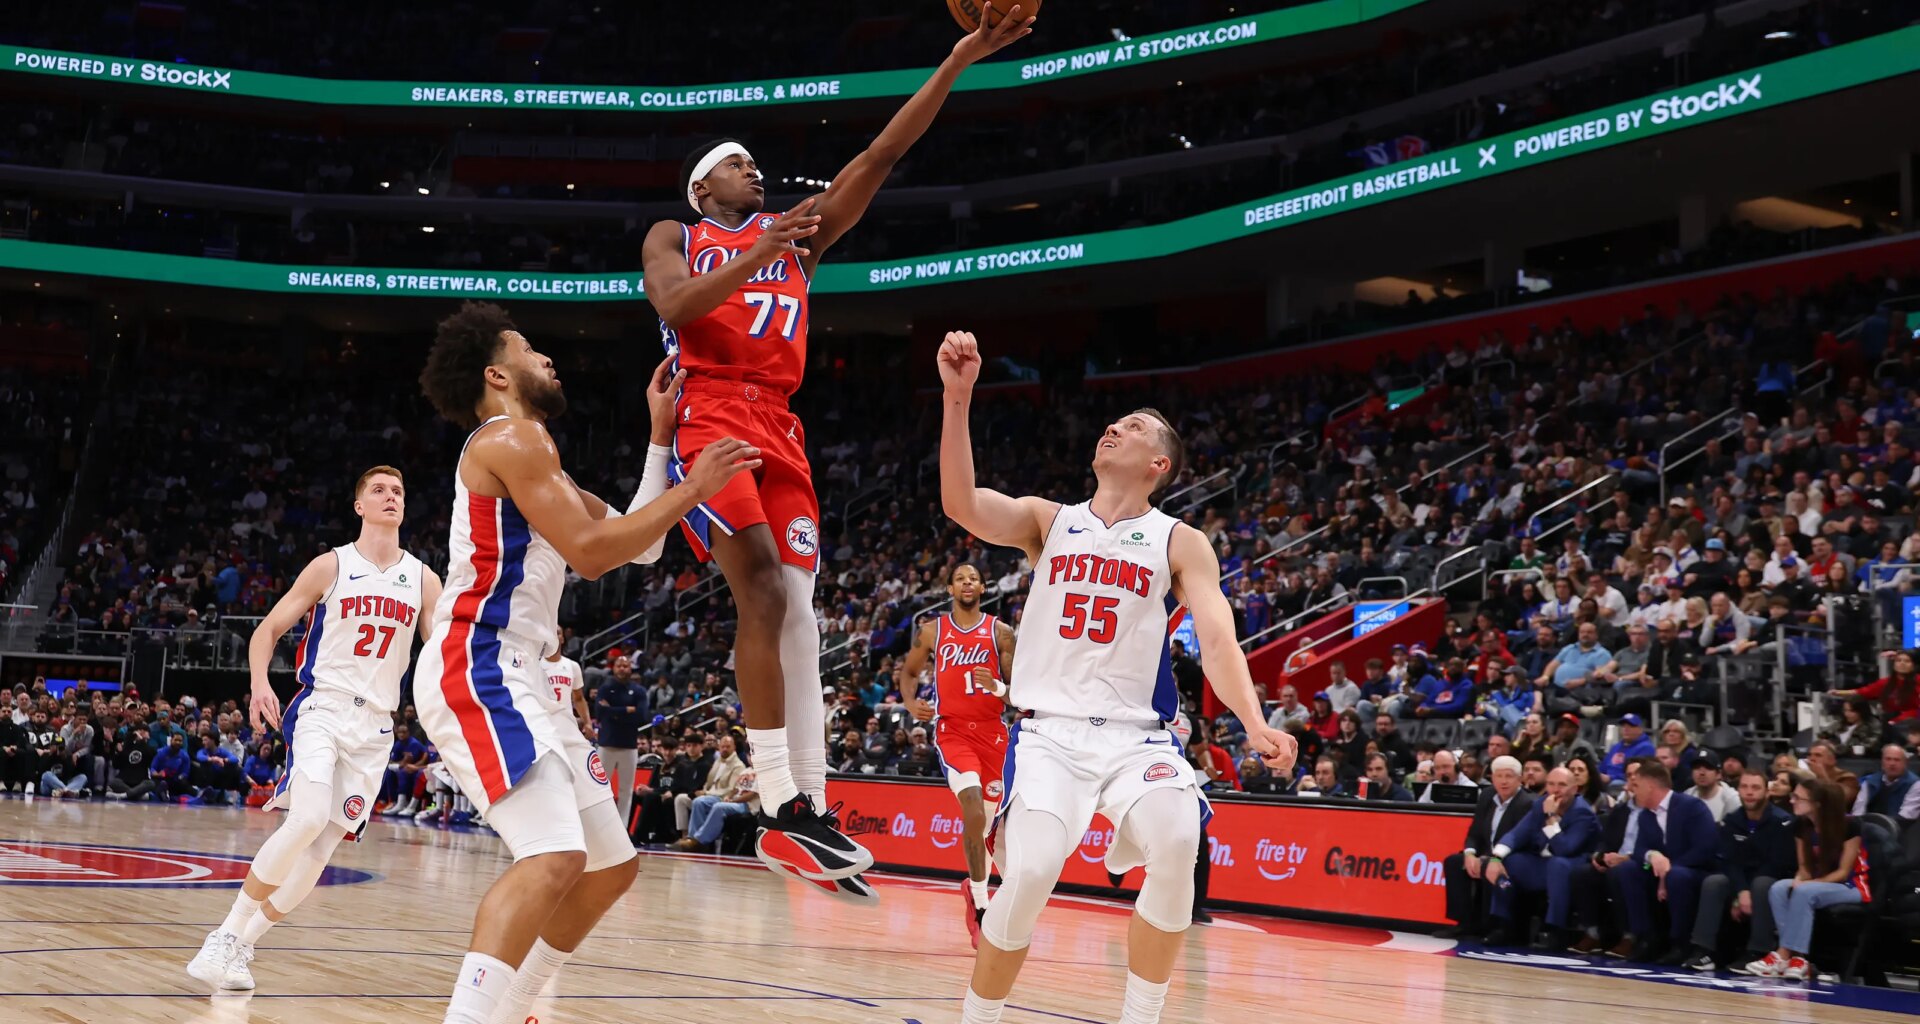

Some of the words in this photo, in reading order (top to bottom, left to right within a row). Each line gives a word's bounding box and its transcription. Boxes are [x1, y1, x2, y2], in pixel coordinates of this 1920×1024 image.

[1021, 58, 1067, 80] SHOP
[1071, 49, 1110, 70] NOW
[1114, 44, 1135, 62] AT
[1139, 21, 1257, 58] STOCKX.COM
[15, 52, 105, 75] POWERED
[110, 62, 135, 78] BY
[140, 63, 231, 90] StockX
[411, 87, 509, 105] SNEAKERS,
[513, 89, 635, 107] STREETWEAR,
[640, 86, 769, 107] COLLECTIBLES,
[773, 84, 785, 99] &
[790, 80, 840, 98] MORE
[1244, 185, 1349, 226] DEEEEETROIT
[1352, 157, 1461, 199] BASKETBALL
[1514, 118, 1610, 158] POWERED
[1616, 109, 1643, 132] BY
[1650, 74, 1761, 125] StockX
[869, 265, 913, 283] SHOP
[915, 260, 951, 278] NOW
[954, 257, 974, 273] AT
[977, 243, 1084, 271] STOCKX.COM
[288, 271, 381, 290] SNEAKERS,
[386, 274, 502, 293] STREETWEAR,
[507, 278, 633, 295] COLLECTIBLES,
[743, 291, 800, 341] 77
[1048, 553, 1154, 599] PISTONS
[340, 595, 416, 628] PISTONS
[1058, 592, 1121, 645] 55
[353, 623, 397, 660] 27
[939, 642, 991, 673] Phila
[845, 809, 889, 835] Game.
[892, 812, 917, 838] On.
[930, 813, 951, 833] fire
[1255, 838, 1286, 862] fire
[1287, 842, 1308, 865] tv
[1323, 846, 1401, 882] Game.
